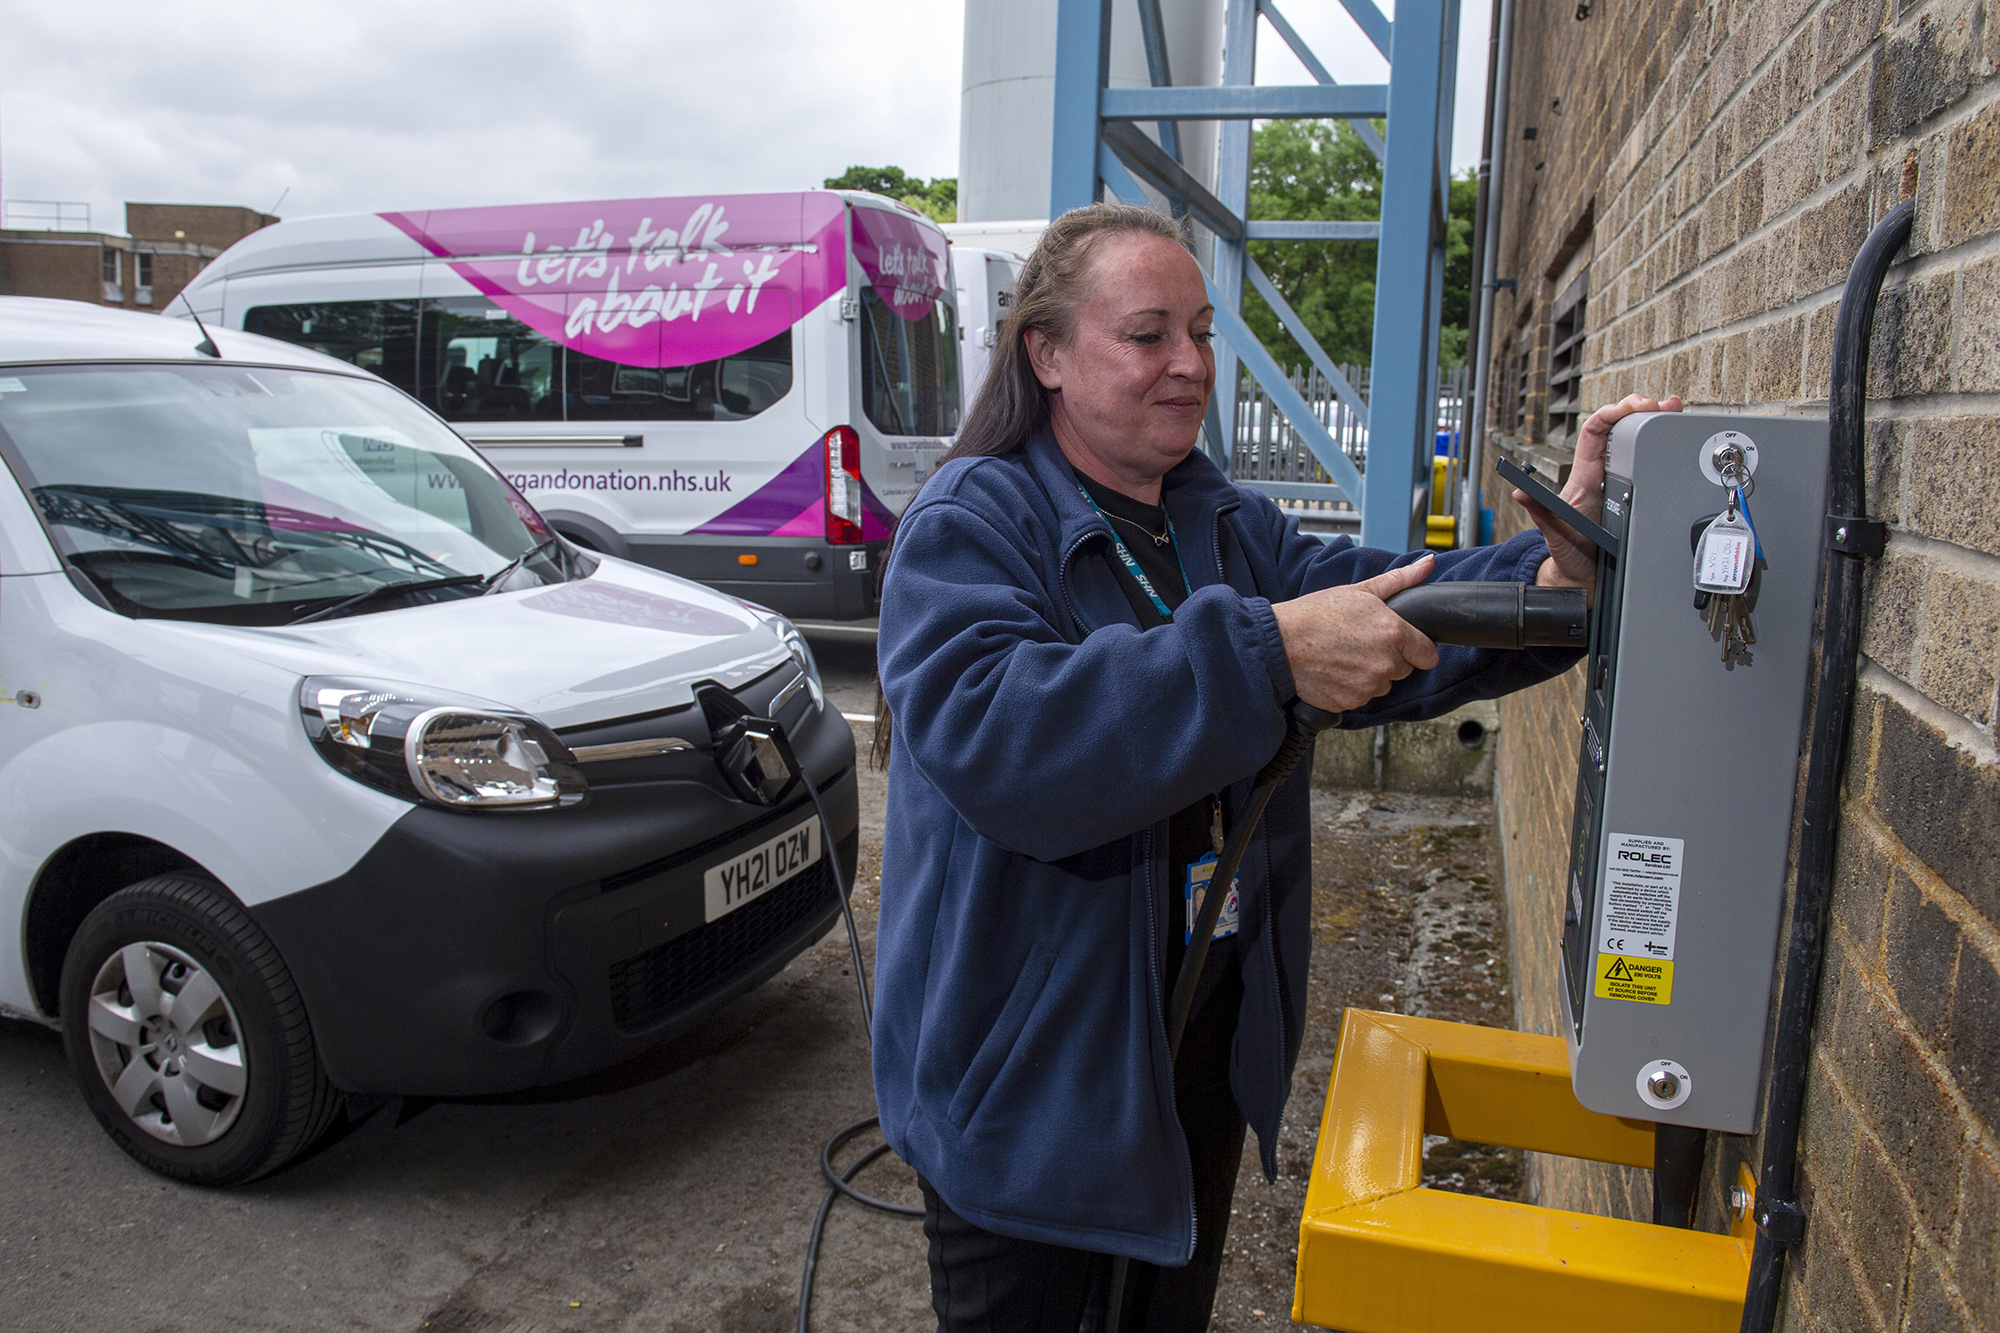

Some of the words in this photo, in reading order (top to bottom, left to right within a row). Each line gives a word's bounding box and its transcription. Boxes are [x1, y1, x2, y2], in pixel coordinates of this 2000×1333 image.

[518, 219, 614, 287] Let's
[628, 203, 734, 272] talk
[879, 244, 904, 275] Let's
[908, 245, 929, 275] talk
[566, 267, 722, 338] about
[727, 255, 780, 314] it
[894, 276, 927, 306] about
[428, 469, 732, 493] wwrgandonation.nhs.uk
[1116, 542, 1136, 567] NHS
[1136, 574, 1158, 598] NHS
[721, 848, 770, 905] YH21
[775, 826, 809, 877] OZW
[1618, 851, 1672, 864] ROLEC
[1629, 964, 1662, 973] DANGER
